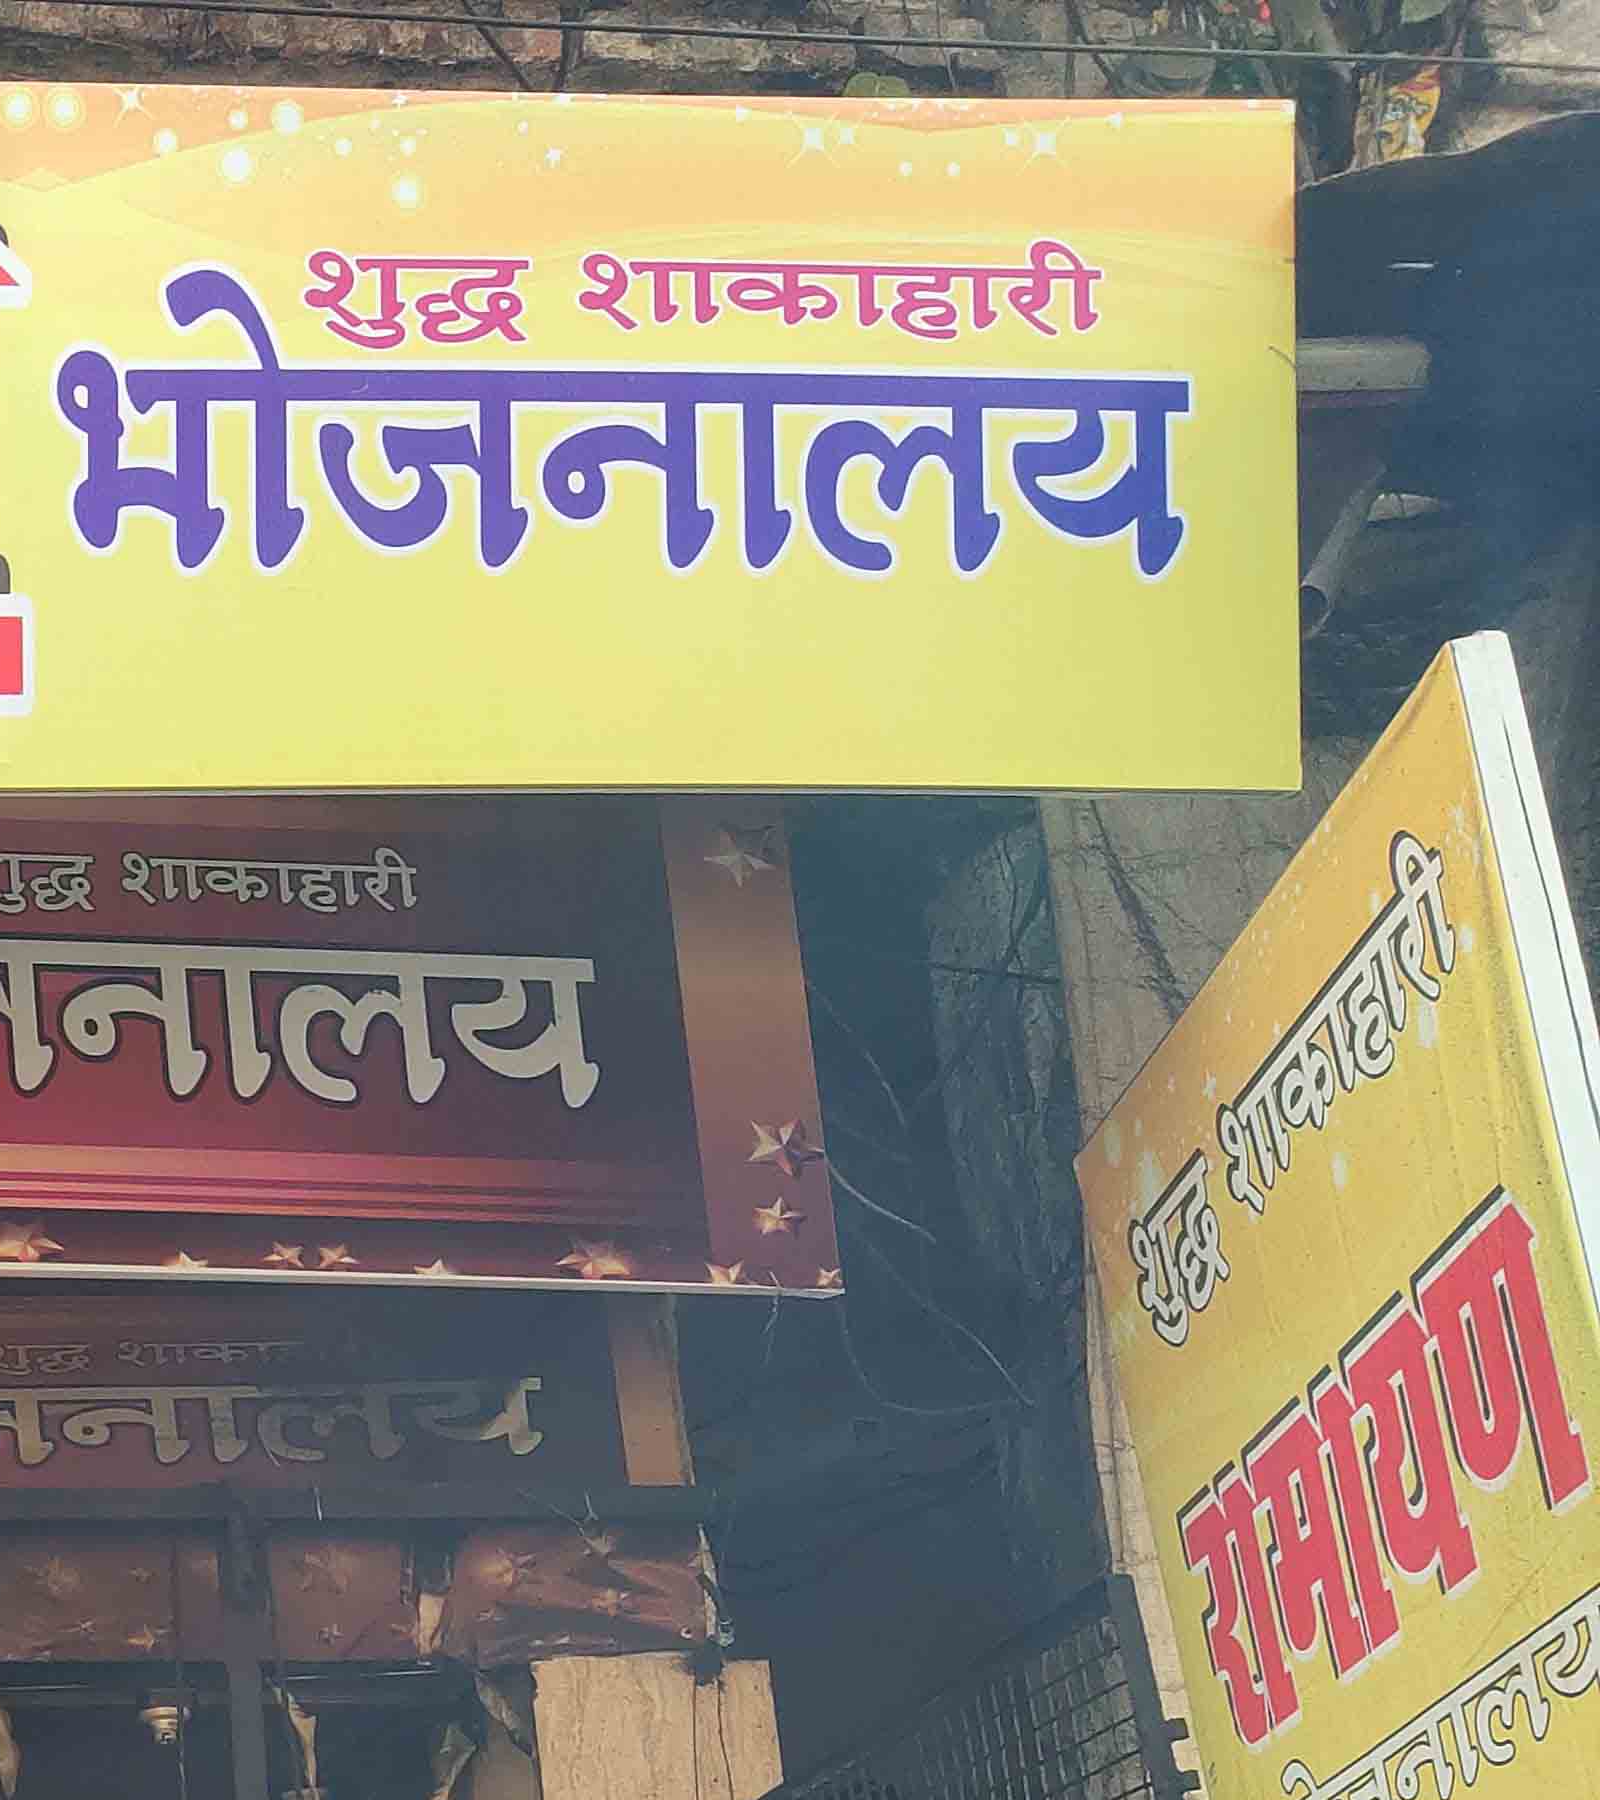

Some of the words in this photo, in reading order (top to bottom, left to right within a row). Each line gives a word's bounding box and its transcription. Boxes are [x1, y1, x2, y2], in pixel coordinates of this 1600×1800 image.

[56, 270, 1189, 574] भोजनालय
[305, 250, 528, 348] शुद्ध
[581, 240, 1102, 338] शाकाहारी
[122, 847, 417, 914] शाकाहारी
[1127, 1148, 1230, 1348] शुद्ध
[1216, 830, 1457, 1216] शाकाहारी
[1175, 1183, 1593, 1750] रामायण
